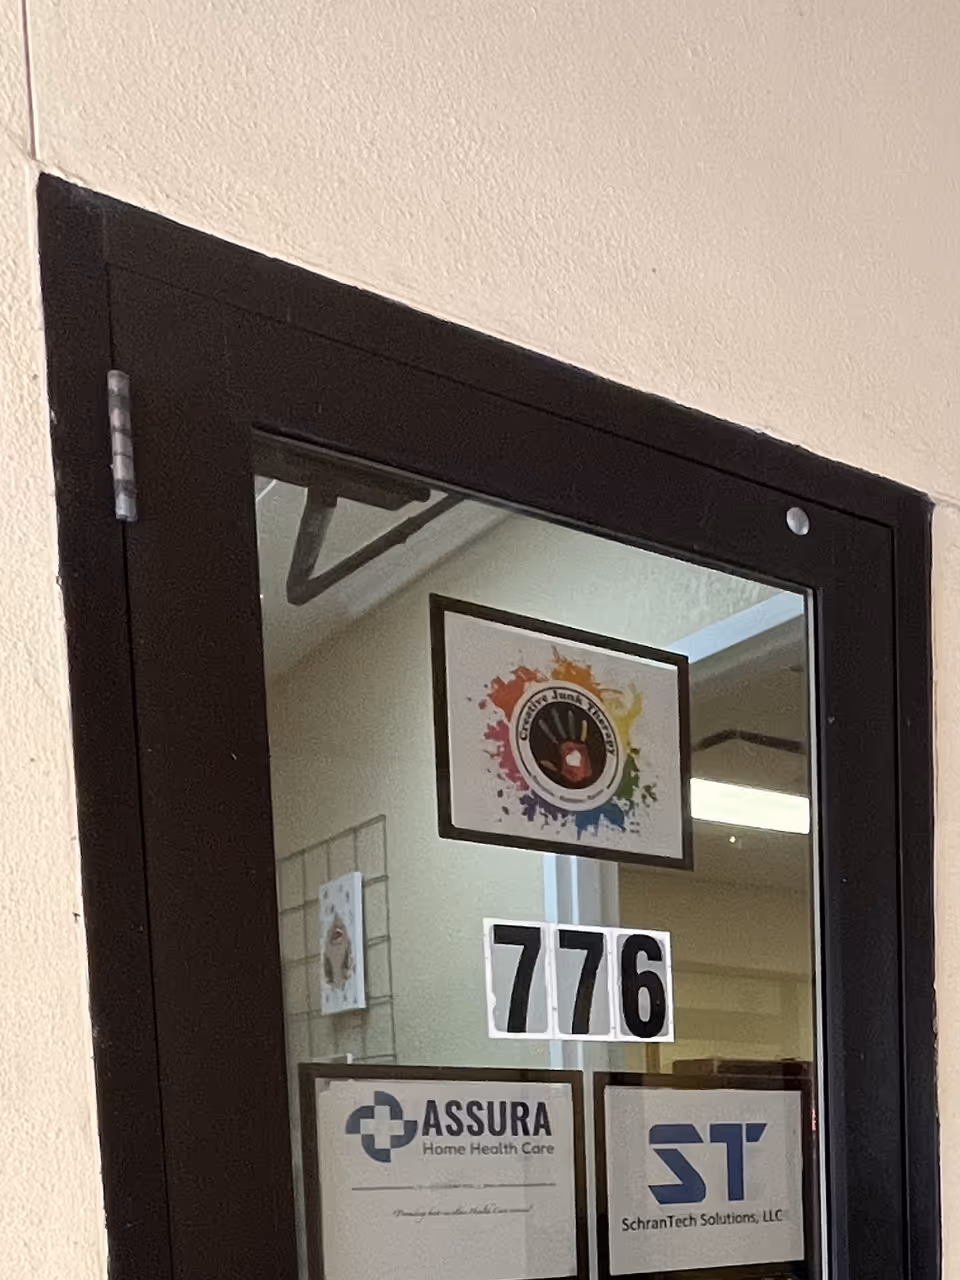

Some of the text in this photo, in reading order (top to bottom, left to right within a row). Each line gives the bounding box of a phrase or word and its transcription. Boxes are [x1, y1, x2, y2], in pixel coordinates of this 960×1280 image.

[519, 690, 616, 756] Creative Junk Therapy
[493, 924, 666, 1038] 776
[422, 1099, 552, 1137] ASSURA
[423, 1142, 555, 1155] Home Health Care
[622, 1209, 783, 1232] SchranTech Solutions, LLC
